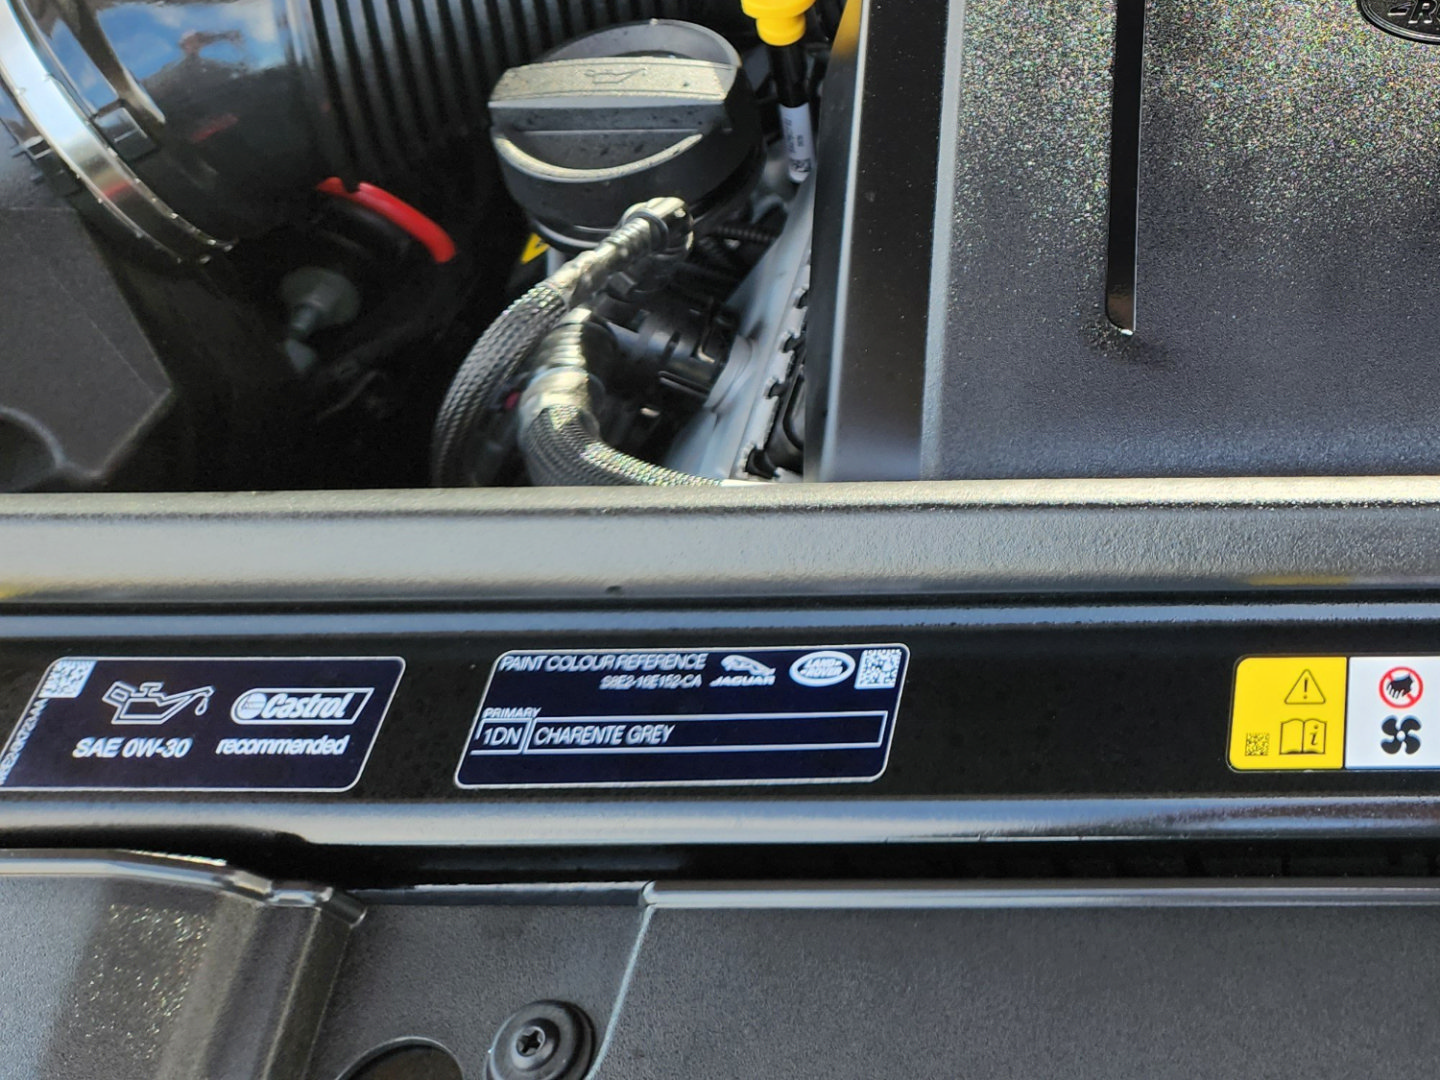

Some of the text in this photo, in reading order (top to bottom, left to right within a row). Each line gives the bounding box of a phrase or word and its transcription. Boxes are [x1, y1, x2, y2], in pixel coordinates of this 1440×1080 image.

[500, 653, 709, 671] PAINT COLOUR REFERENCE
[709, 675, 777, 688] JAGUAR
[260, 692, 355, 719] Castrol
[481, 707, 541, 719] PRIMARY
[215, 734, 351, 756] recommended
[482, 726, 523, 746] 1DN
[533, 724, 676, 746] CHARENTE GREY
[72, 736, 194, 758] SAE 0W-30
